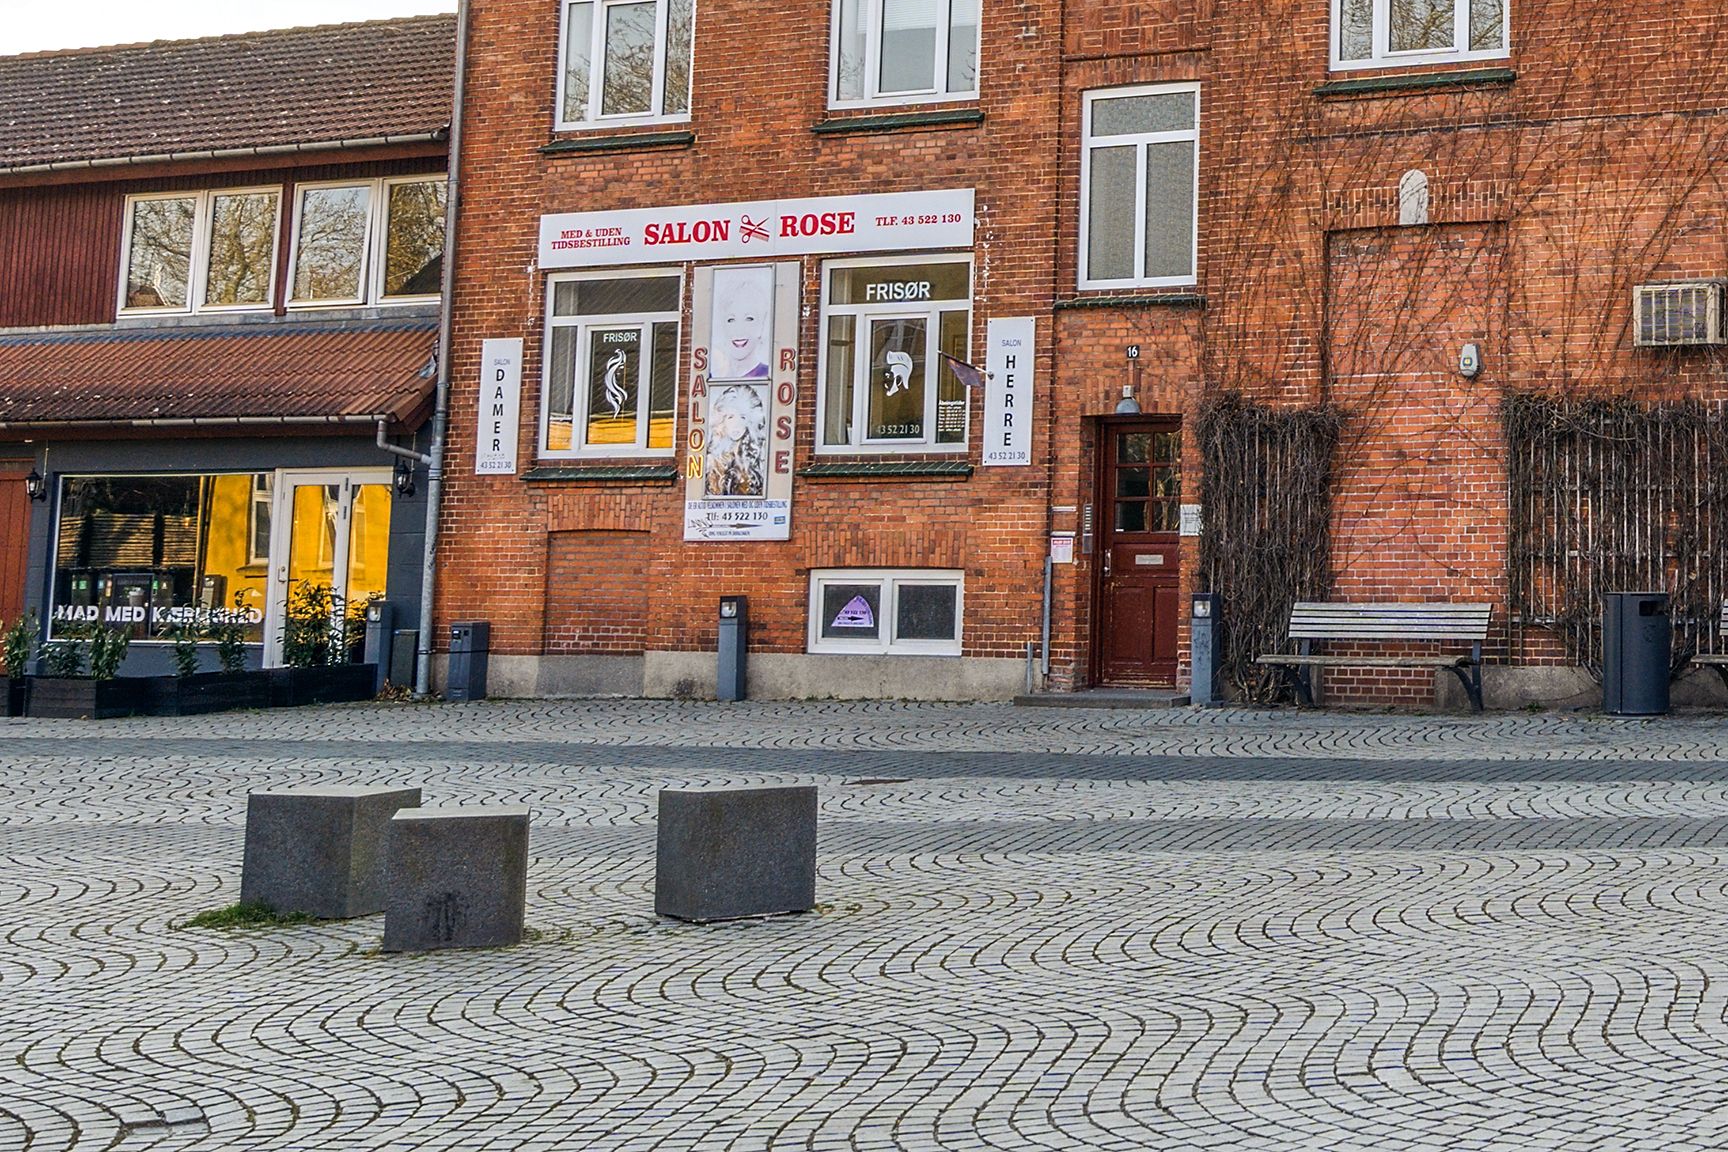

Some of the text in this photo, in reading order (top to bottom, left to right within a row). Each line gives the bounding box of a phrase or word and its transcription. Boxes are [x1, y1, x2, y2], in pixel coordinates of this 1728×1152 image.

[779, 212, 856, 238] ROSE
[875, 213, 961, 226] TLF. 43 522 130
[561, 227, 622, 240] MED & UDEN
[643, 219, 731, 246] SALON
[551, 236, 631, 250] TIDSBESTILLING
[866, 281, 931, 301] FRISØR
[603, 332, 638, 343] FRISØR
[1001, 339, 1022, 347] SALON
[1127, 346, 1139, 358] 16
[1003, 355, 1016, 446] HERRE
[492, 369, 505, 451] DAMER
[687, 348, 708, 479] SALON
[775, 348, 796, 475] ROSE
[887, 425, 898, 434] 52
[909, 424, 920, 433] 30
[988, 452, 997, 460] 43
[998, 452, 1008, 460] 52
[1017, 451, 1026, 459] 30
[480, 461, 488, 469] 43
[722, 512, 732, 521] 43
[735, 512, 750, 520] 522
[753, 511, 769, 520] 130
[57, 604, 99, 622] MAD
[105, 605, 146, 622] MED
